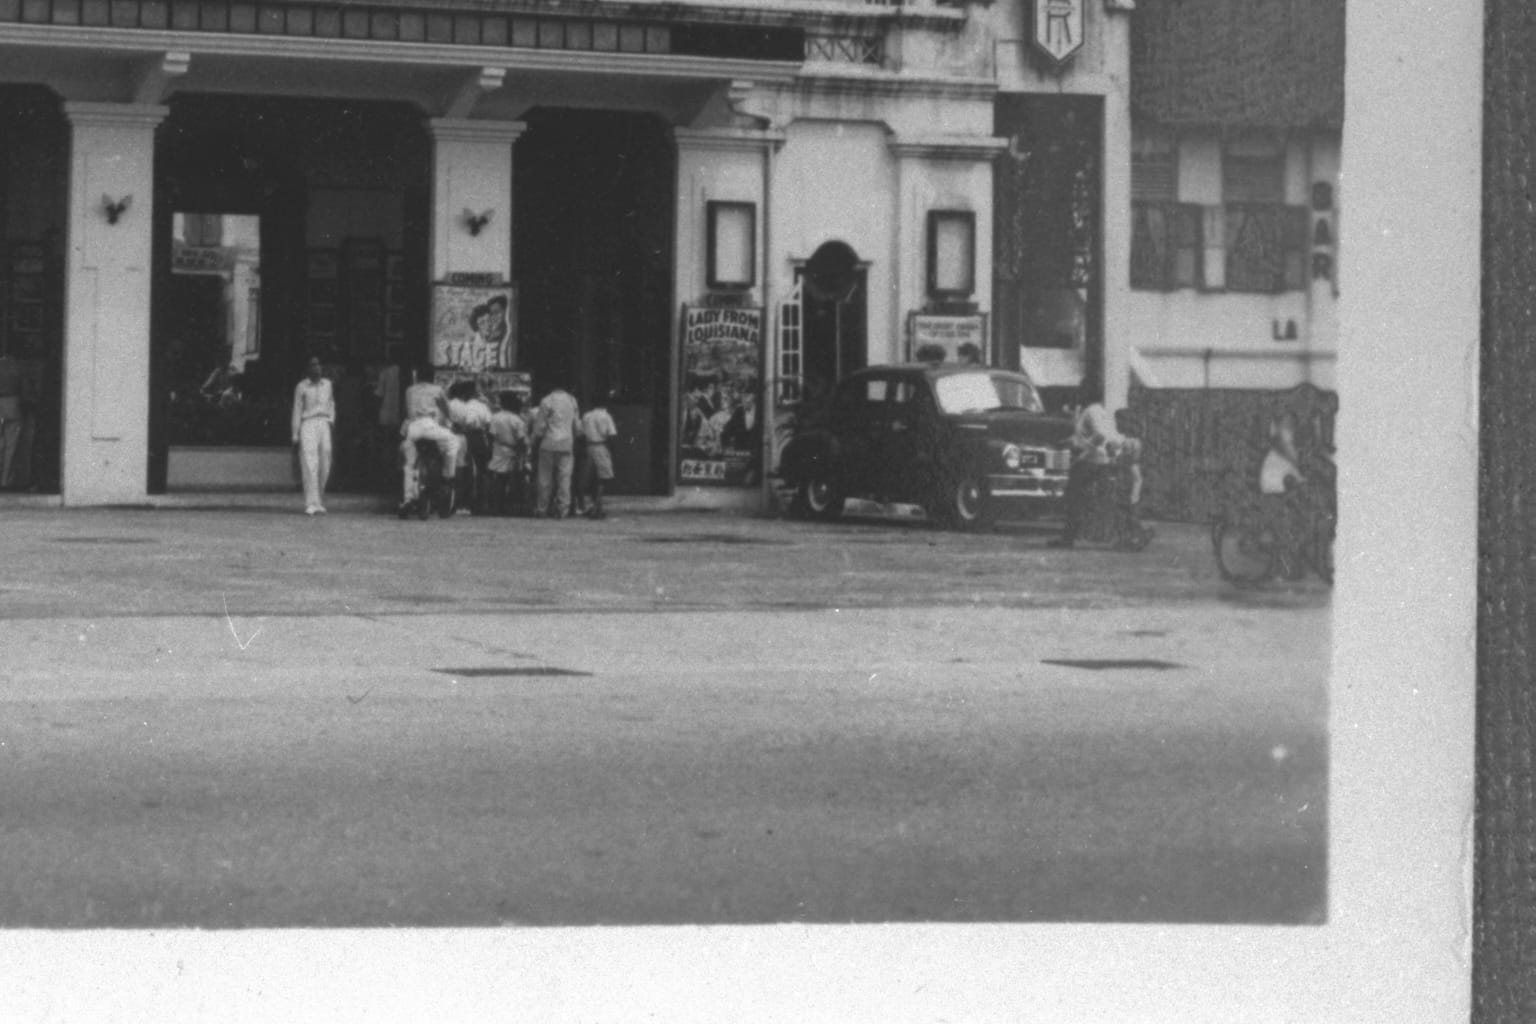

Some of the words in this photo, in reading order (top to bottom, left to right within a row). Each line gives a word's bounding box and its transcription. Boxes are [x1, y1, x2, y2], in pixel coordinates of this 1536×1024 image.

[688, 310, 721, 328] LADY
[723, 309, 760, 330] FROM
[688, 325, 760, 345] LOUISIANA
[433, 338, 499, 373] STAGE
